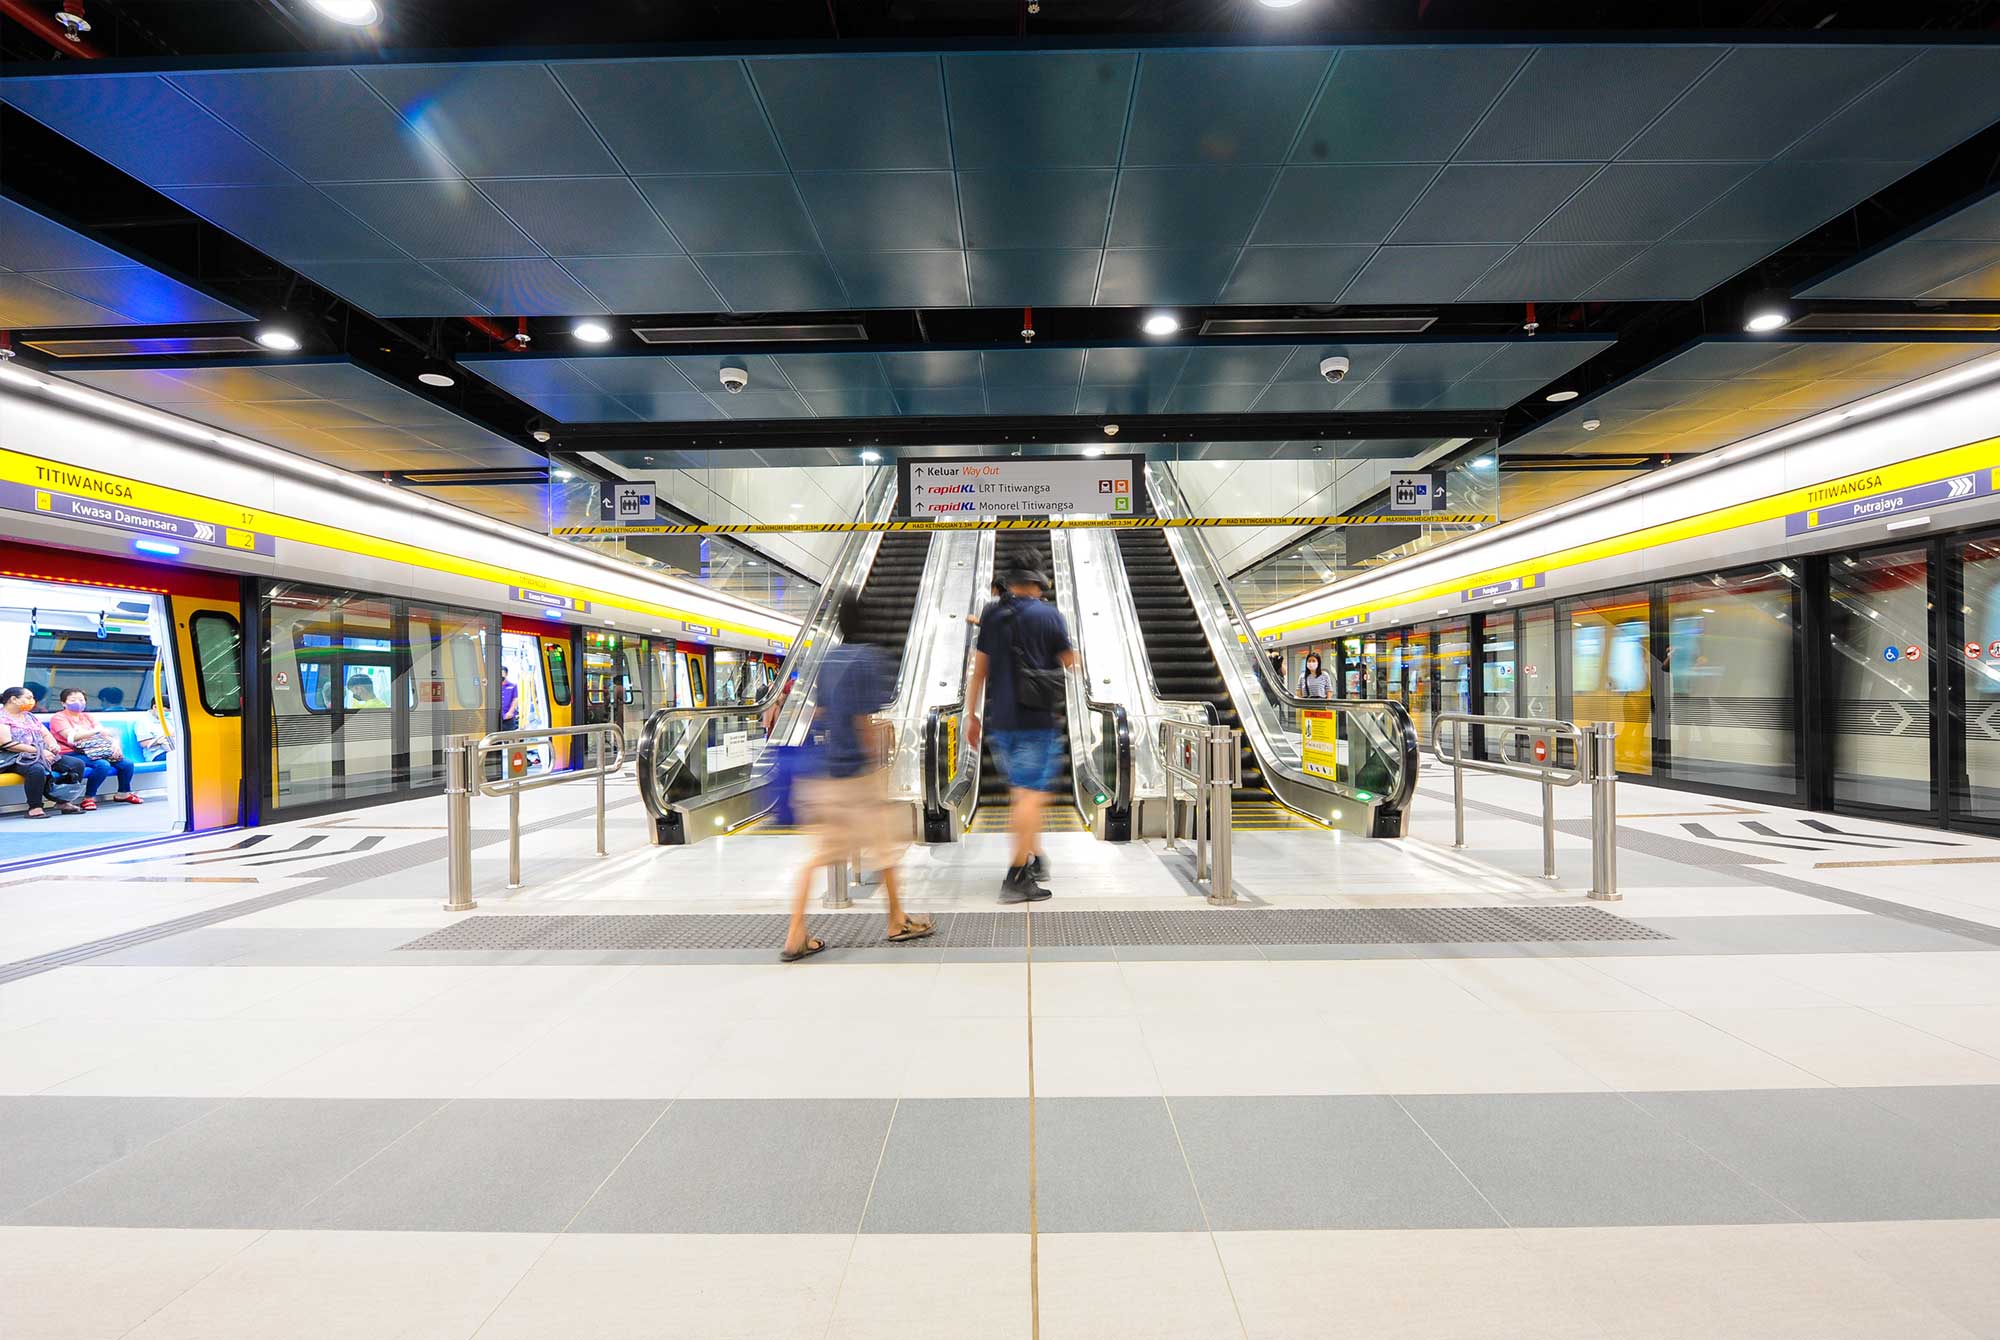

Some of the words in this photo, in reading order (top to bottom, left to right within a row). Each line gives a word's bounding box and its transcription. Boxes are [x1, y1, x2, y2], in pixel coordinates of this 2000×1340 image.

[927, 466, 960, 476] Keluar
[962, 466, 981, 478] Way
[982, 466, 1000, 476] Out
[36, 466, 133, 500] TITIWANGSA
[928, 484, 976, 496] rapidKL
[979, 483, 996, 493] LRT
[999, 483, 1050, 494] Titiwangsa
[1808, 475, 1882, 503] TITIWANGSA
[928, 502, 976, 513] rapidKL
[980, 502, 1020, 510] Monorel
[1022, 501, 1074, 512] Titiwangsa
[1853, 497, 1904, 516] Putrajaya
[72, 502, 112, 520] Kwasa
[115, 510, 178, 532] Damansara
[242, 512, 254, 525] 17
[244, 534, 253, 548] 2
